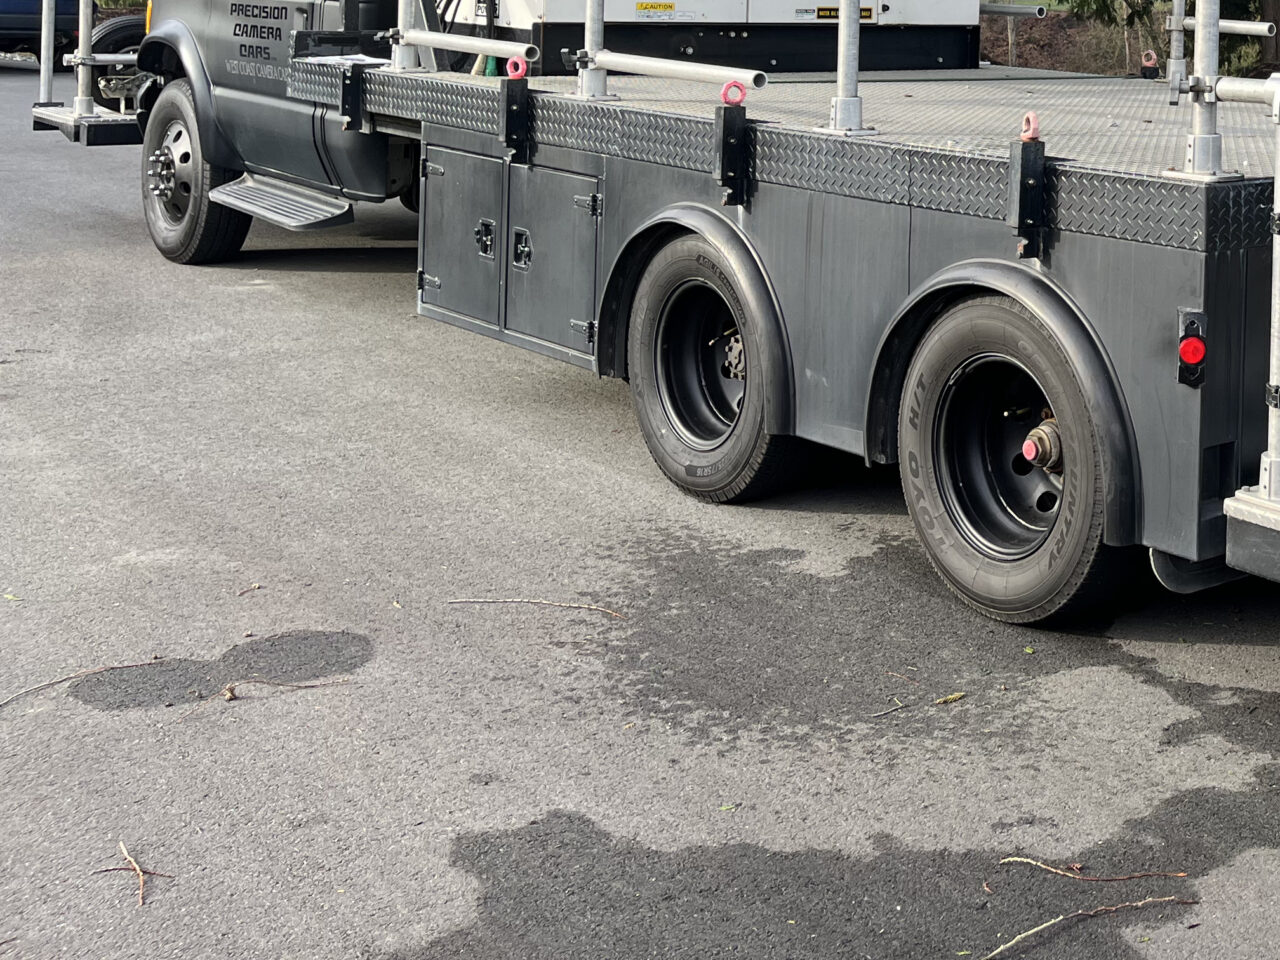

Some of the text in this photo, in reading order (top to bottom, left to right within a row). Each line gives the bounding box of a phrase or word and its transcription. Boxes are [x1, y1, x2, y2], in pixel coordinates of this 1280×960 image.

[230, 2, 288, 20] PRECISION
[643, 3, 673, 11] CAUTION
[233, 23, 282, 42] CAMERA
[239, 43, 271, 61] CARS
[907, 373, 955, 555] TOYO H/T
